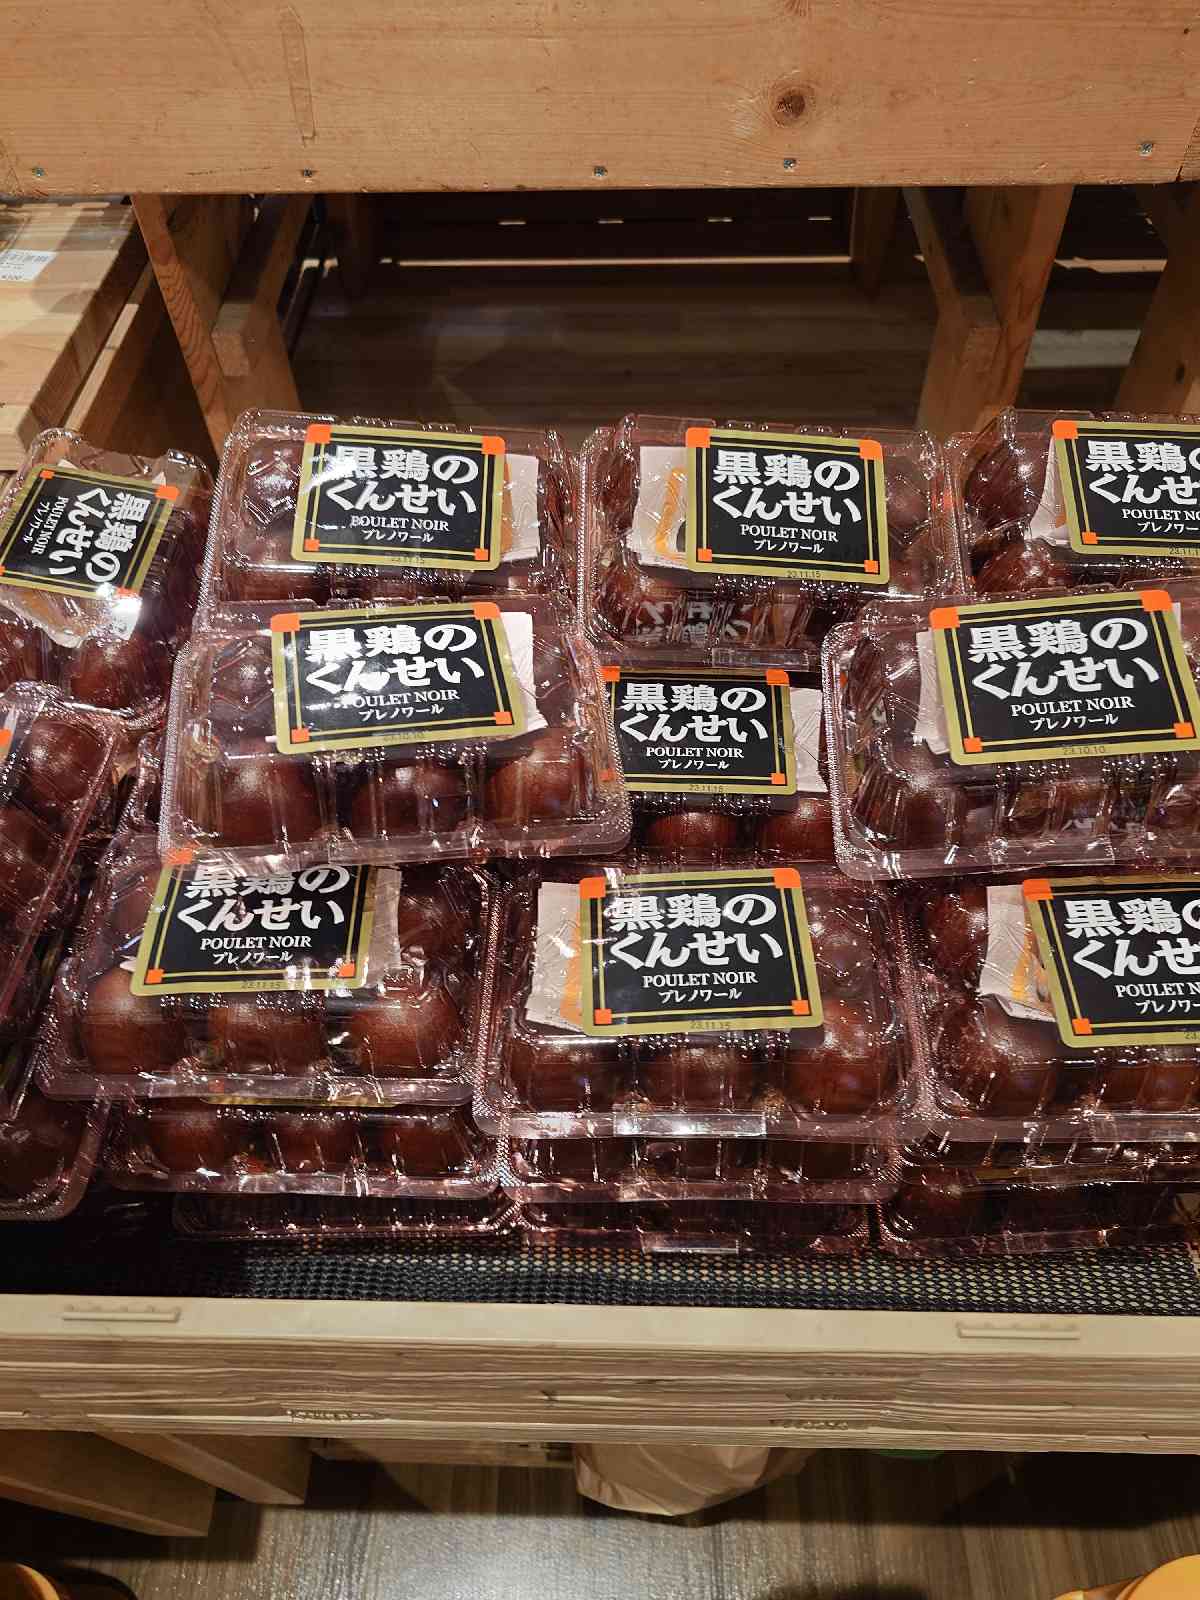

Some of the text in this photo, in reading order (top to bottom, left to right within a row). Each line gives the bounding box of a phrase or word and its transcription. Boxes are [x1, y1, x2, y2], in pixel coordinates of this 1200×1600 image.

[713, 449, 860, 491] 黒鶏の
[1085, 440, 1200, 474] 黒鶏
[325, 480, 478, 516] くんせい
[712, 485, 862, 525] くんせい
[1122, 508, 1181, 520] POULET
[31, 496, 69, 555] POULET NOIR
[49, 488, 112, 575] くんせい
[410, 517, 450, 532] NOIR
[740, 524, 839, 542] POULET NOIR
[967, 617, 1149, 663] 黒鶏の
[305, 656, 486, 694] くんせい
[971, 657, 1160, 700] くんせい
[414, 689, 461, 702] NOIR
[621, 682, 767, 712] 黒鶏の
[1010, 695, 1136, 717] POULET NOIR
[619, 712, 769, 743] くんせい
[646, 746, 744, 759] POULET NOIR
[177, 898, 345, 933] くんせい
[607, 893, 777, 931] 黒鶏の
[200, 935, 312, 951] POULET NOIR
[609, 931, 784, 970] くんせい
[642, 970, 759, 988] POULET NOIR
[1114, 983, 1184, 998] POULET
